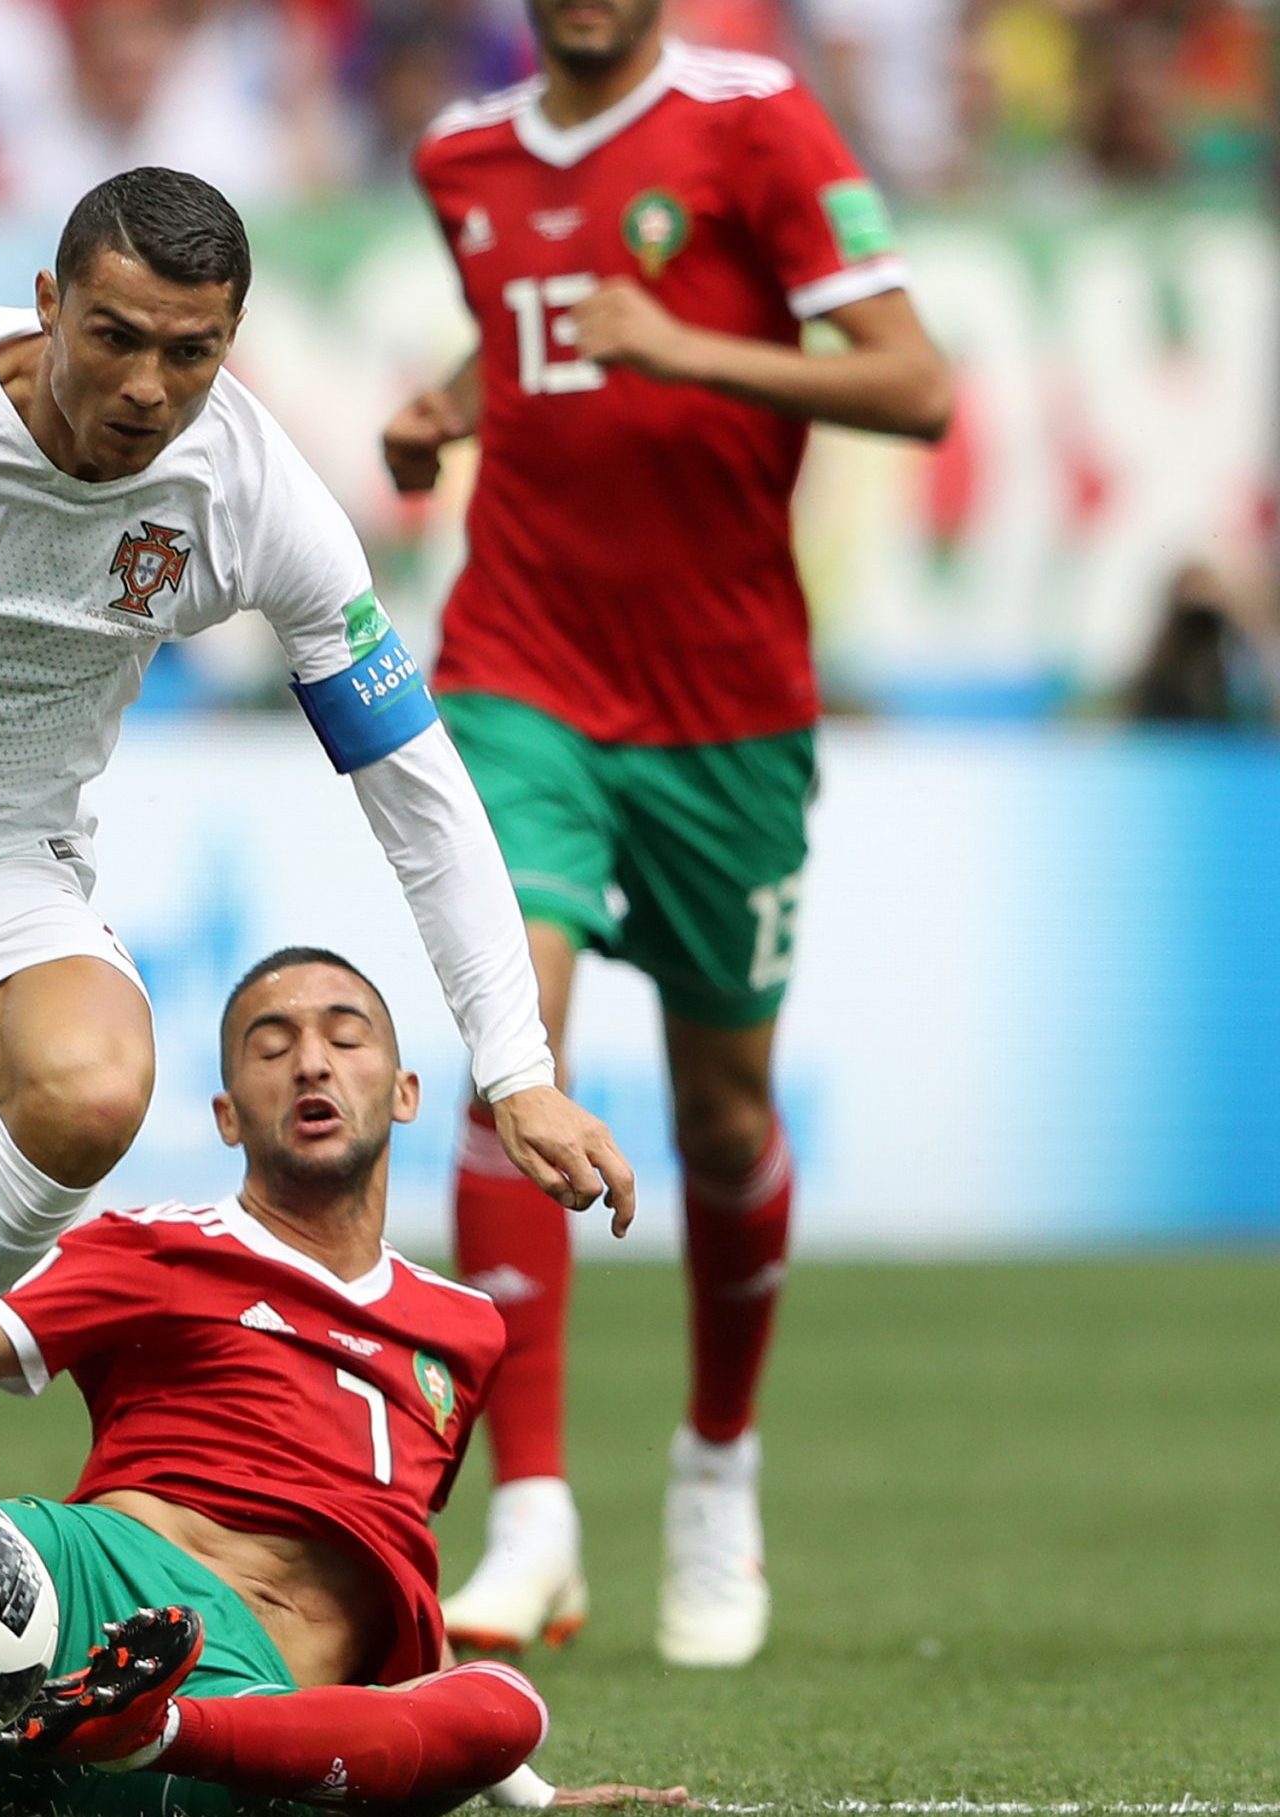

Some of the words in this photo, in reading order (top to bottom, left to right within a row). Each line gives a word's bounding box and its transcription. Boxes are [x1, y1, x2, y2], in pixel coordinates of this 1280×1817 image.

[351, 642, 411, 692] LIVI
[359, 656, 418, 707] FOOTB
[336, 1367, 392, 1485] 7
